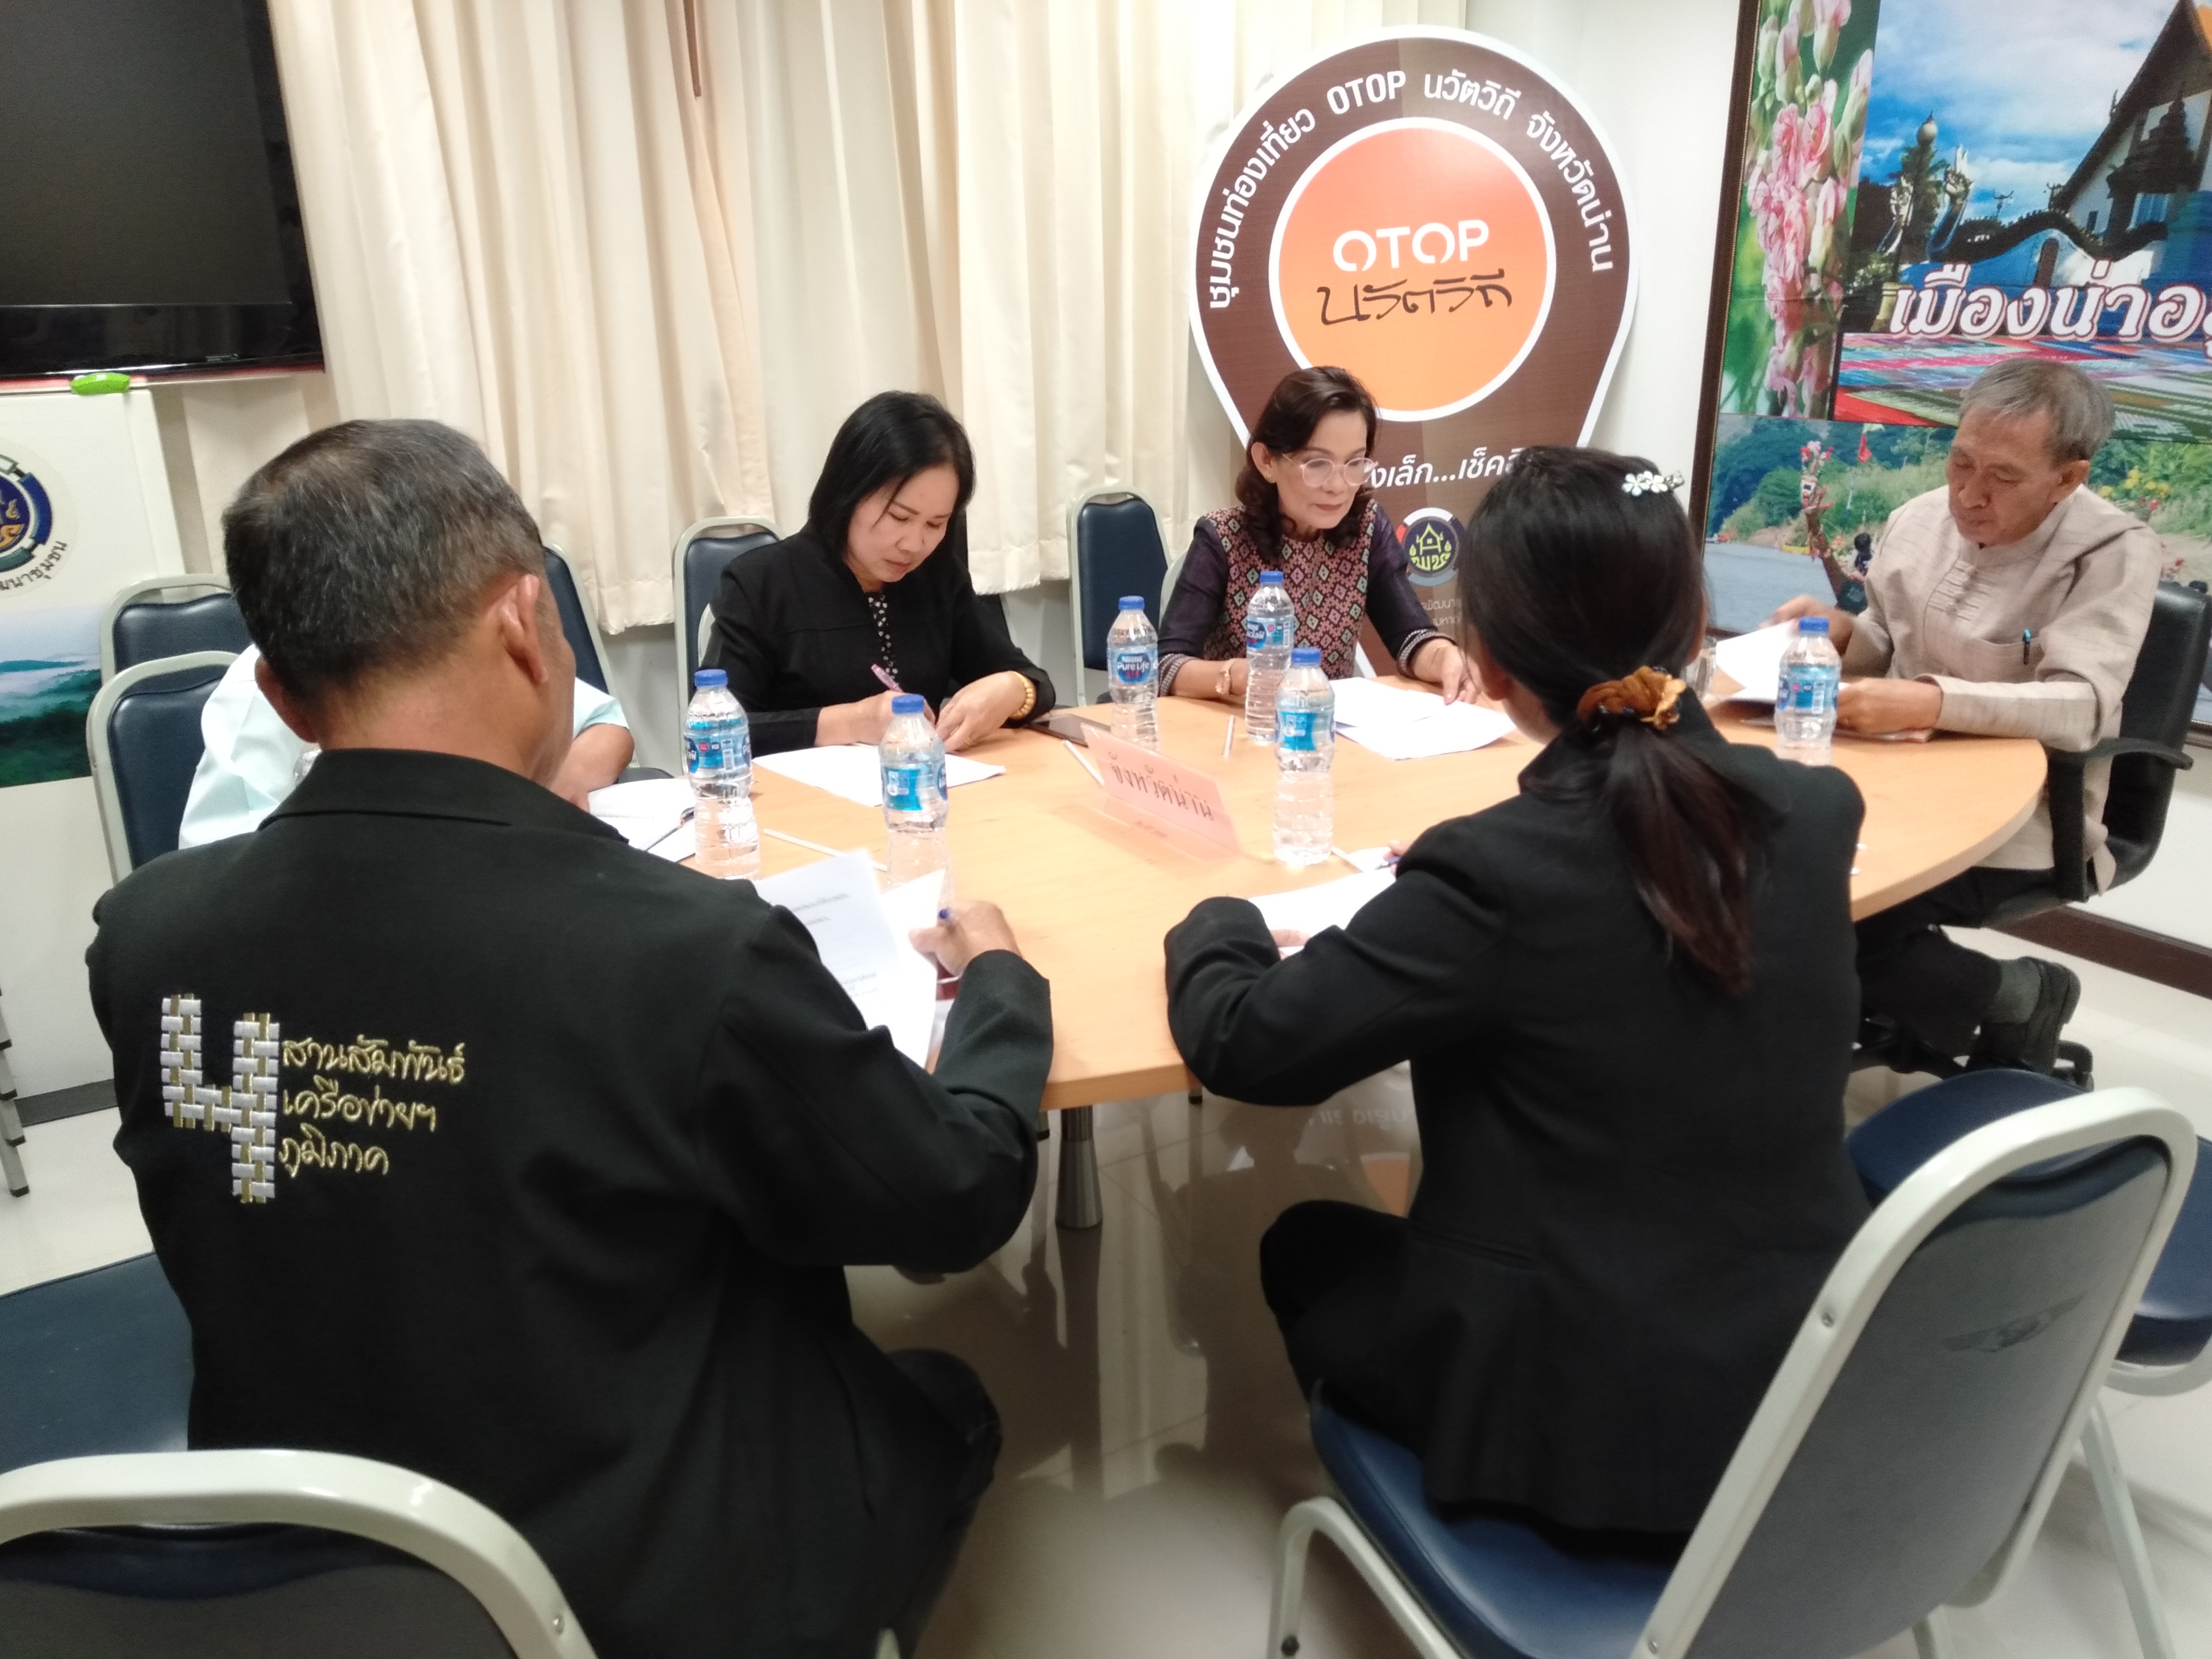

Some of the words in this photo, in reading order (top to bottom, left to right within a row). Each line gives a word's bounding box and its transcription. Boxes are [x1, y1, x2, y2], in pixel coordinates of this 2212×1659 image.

[1210, 108, 1316, 308] ชุมชนท่องเที่ยว
[1326, 70, 1406, 114] OTOP
[1423, 69, 1522, 120] นวัตวิถี
[1526, 110, 1613, 272] จังหวัดน่าน
[1333, 219, 1489, 272] OTOP
[1117, 661, 1136, 671] Pure
[282, 1033, 466, 1085] สานสัมพันธ์
